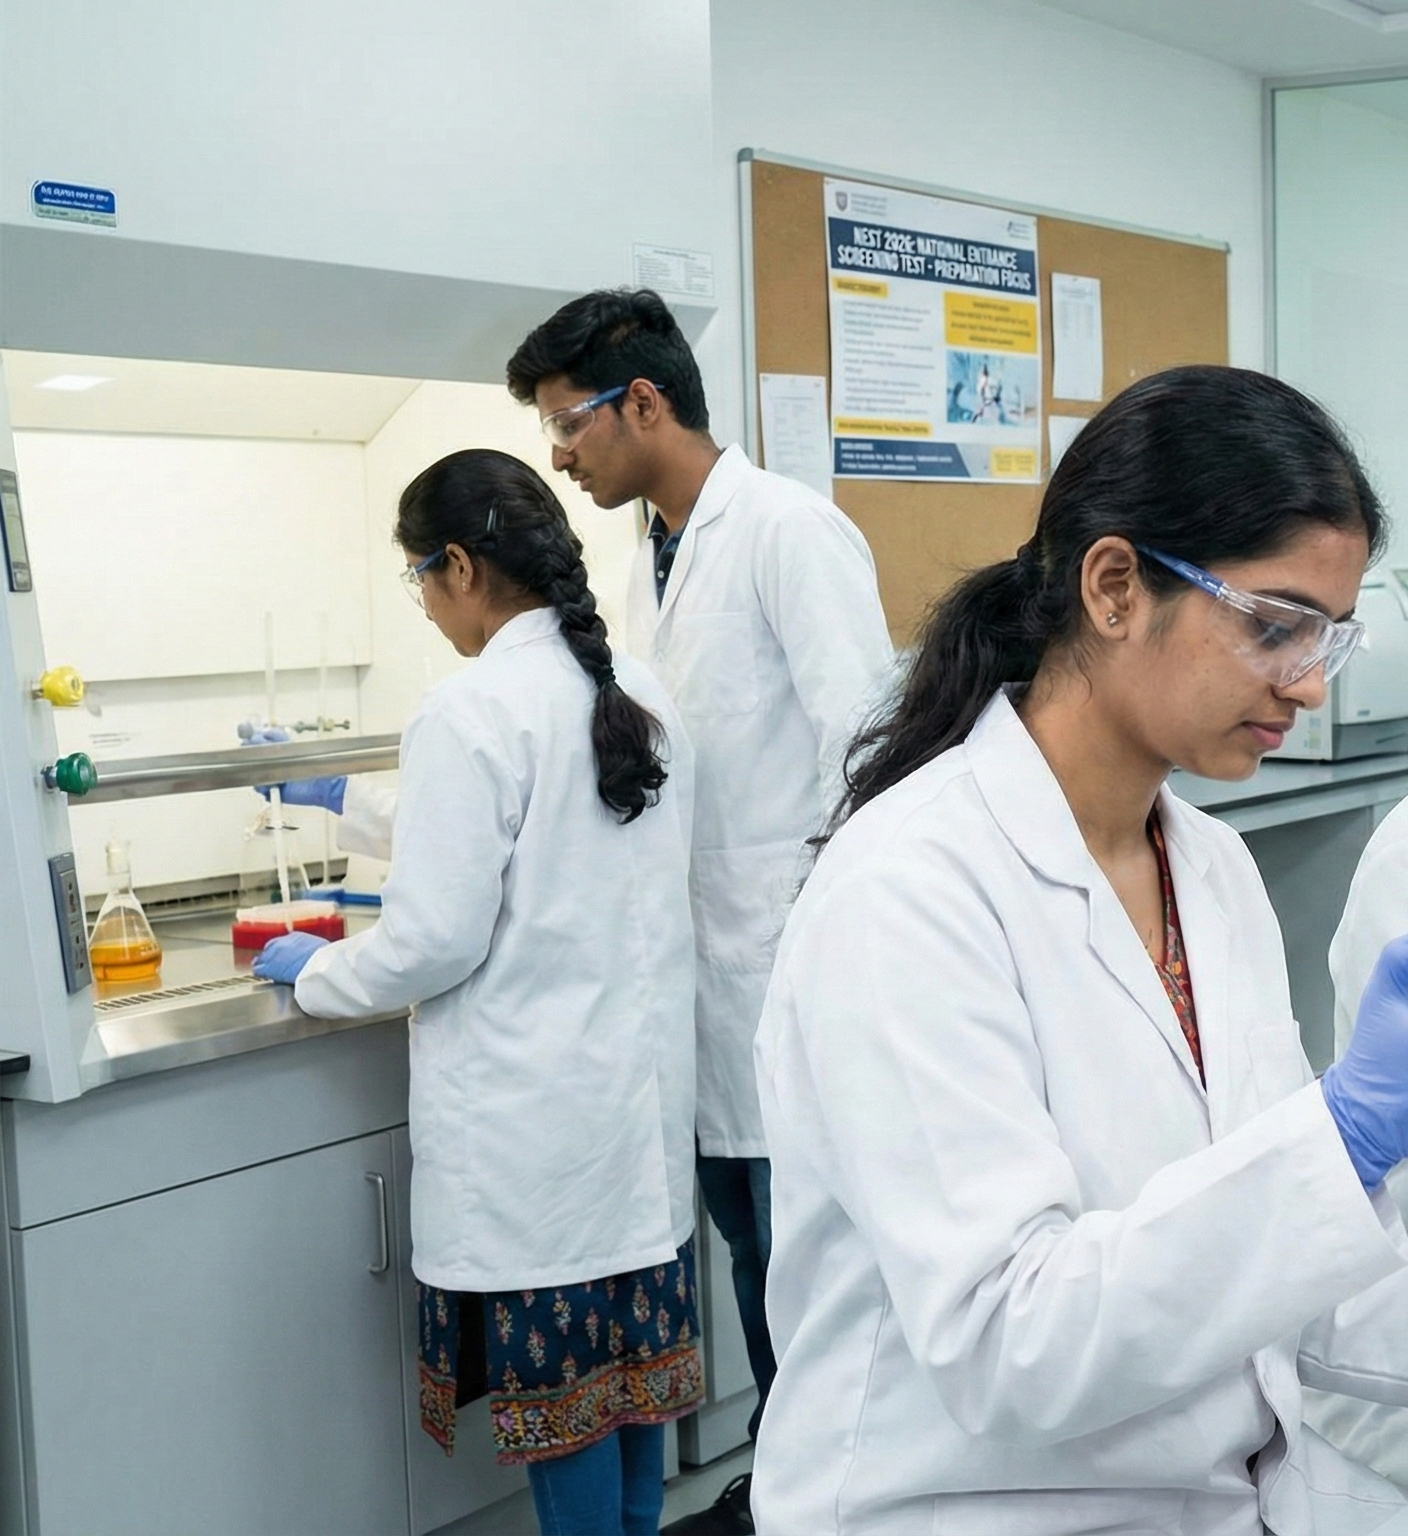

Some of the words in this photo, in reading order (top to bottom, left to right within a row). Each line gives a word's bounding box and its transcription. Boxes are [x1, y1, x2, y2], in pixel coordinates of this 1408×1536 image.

[837, 244, 899, 272] SCREENING
[900, 253, 926, 275] TEST
[934, 258, 1000, 286] PREPARATION
[1001, 268, 1031, 291] FOCUS
[853, 226, 882, 249] NEST
[917, 237, 966, 263] NATIONAL
[967, 244, 1018, 271] ENTRANCE
